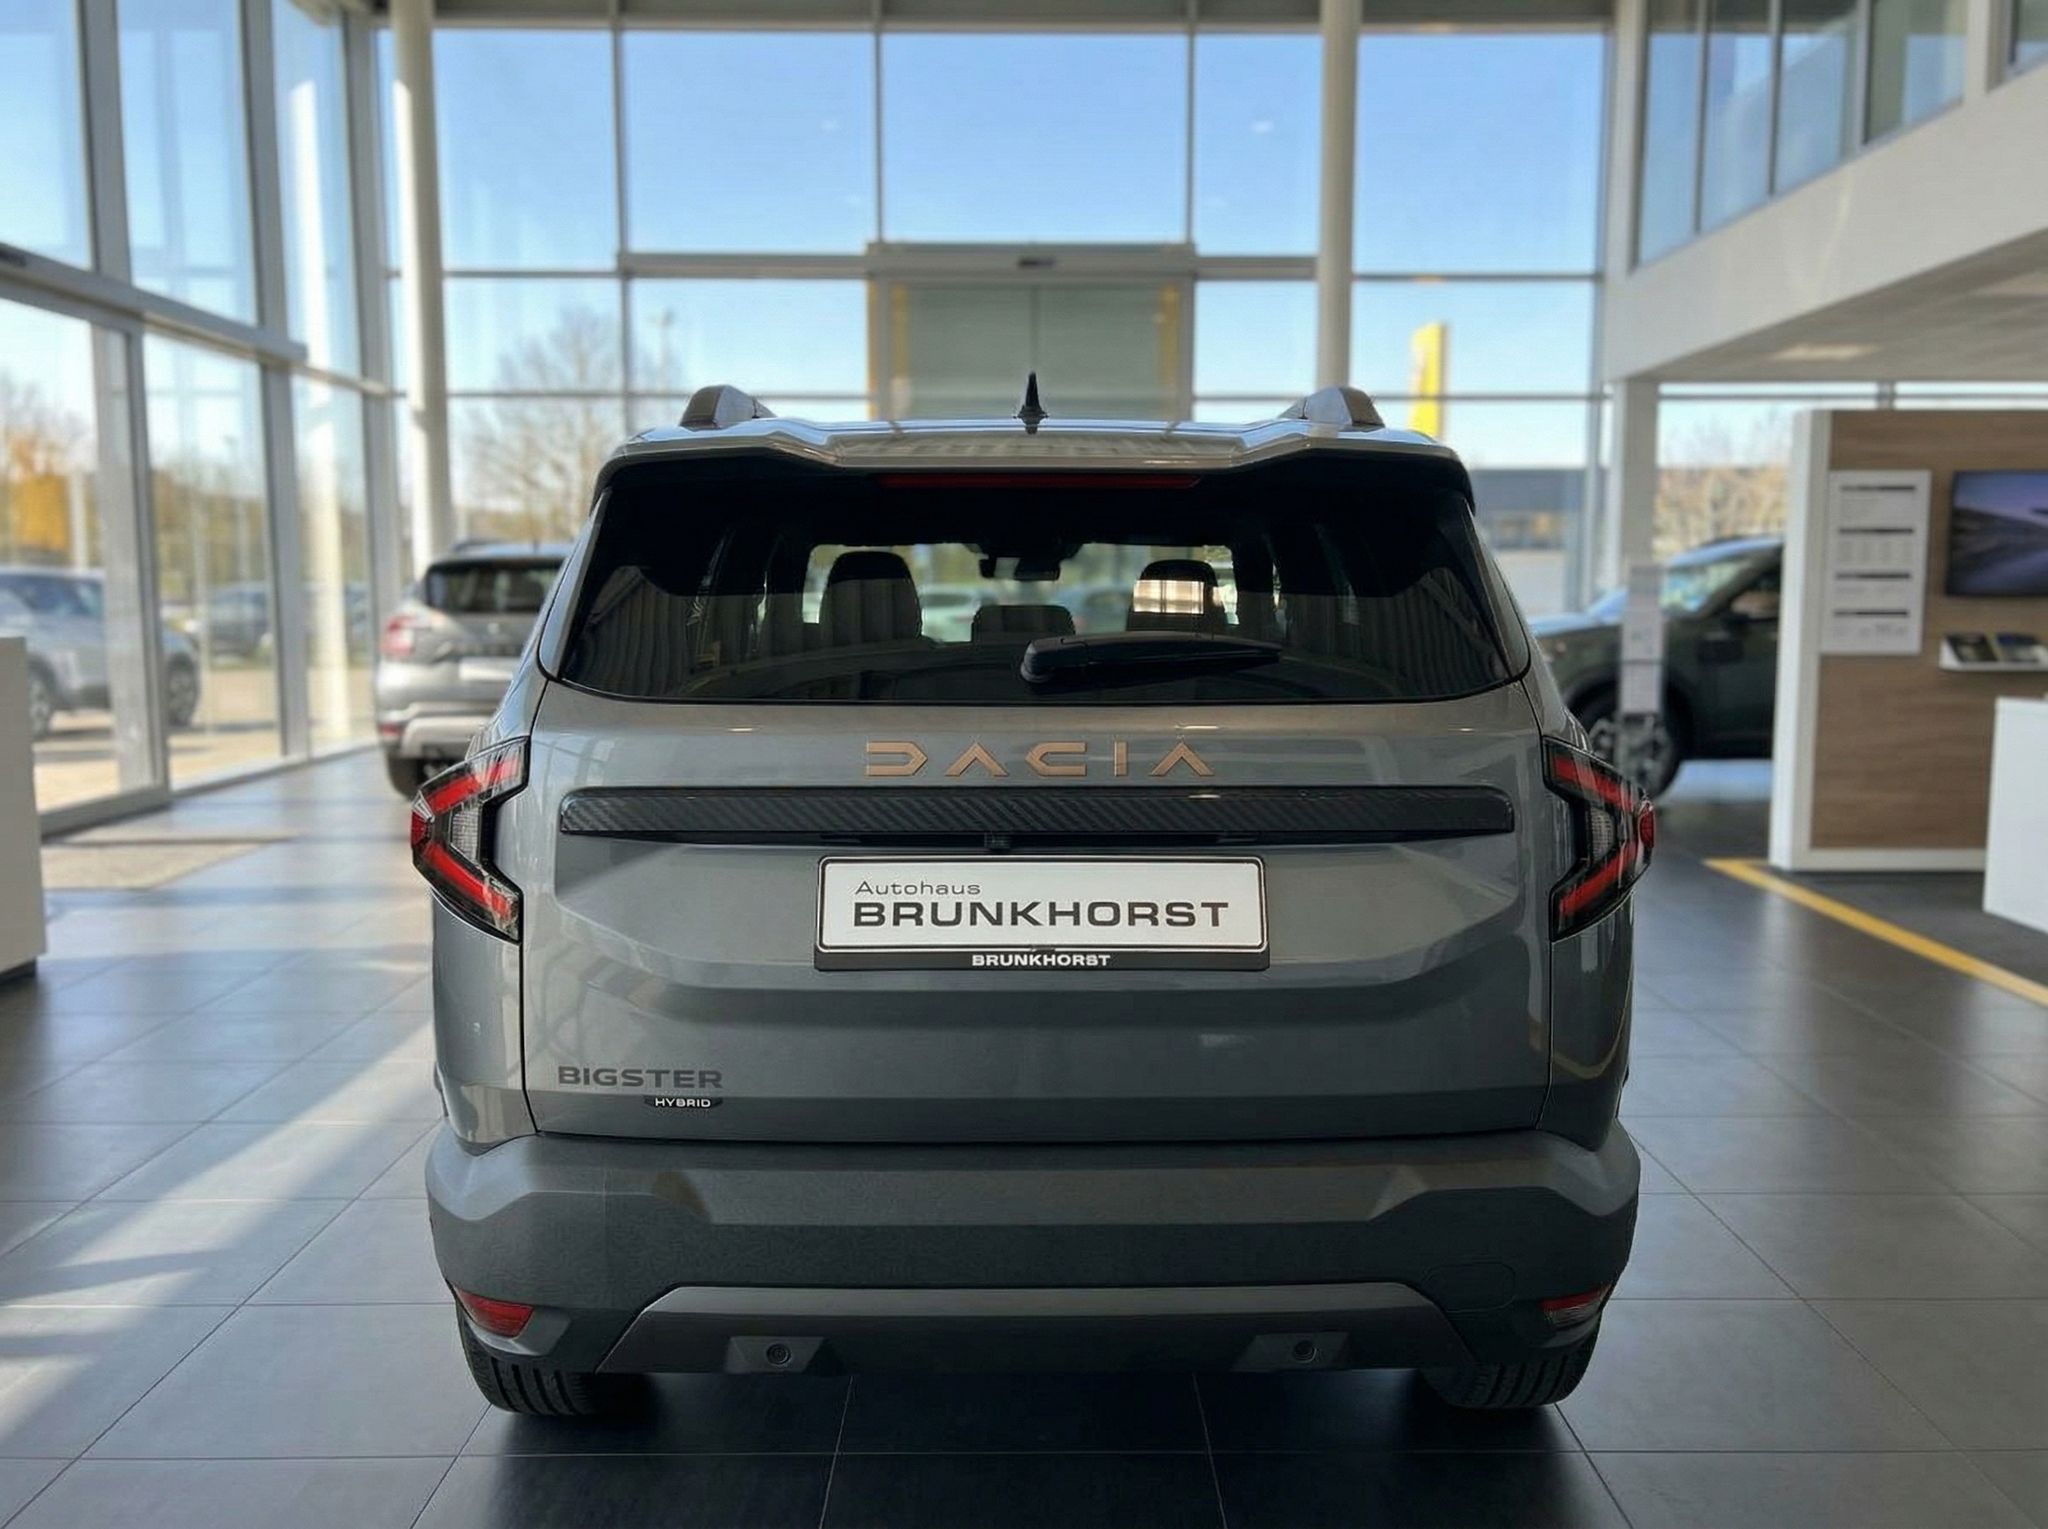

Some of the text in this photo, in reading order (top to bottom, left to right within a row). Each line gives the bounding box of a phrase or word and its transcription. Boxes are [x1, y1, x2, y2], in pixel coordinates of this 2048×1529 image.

[864, 741, 1214, 776] DACIA
[855, 880, 981, 895] Autohaus
[853, 901, 1229, 927] BRUNKHORST
[972, 954, 1111, 967] BRUNKHORST
[558, 1066, 723, 1088] BIGSTER
[655, 1097, 711, 1107] HYBRID
